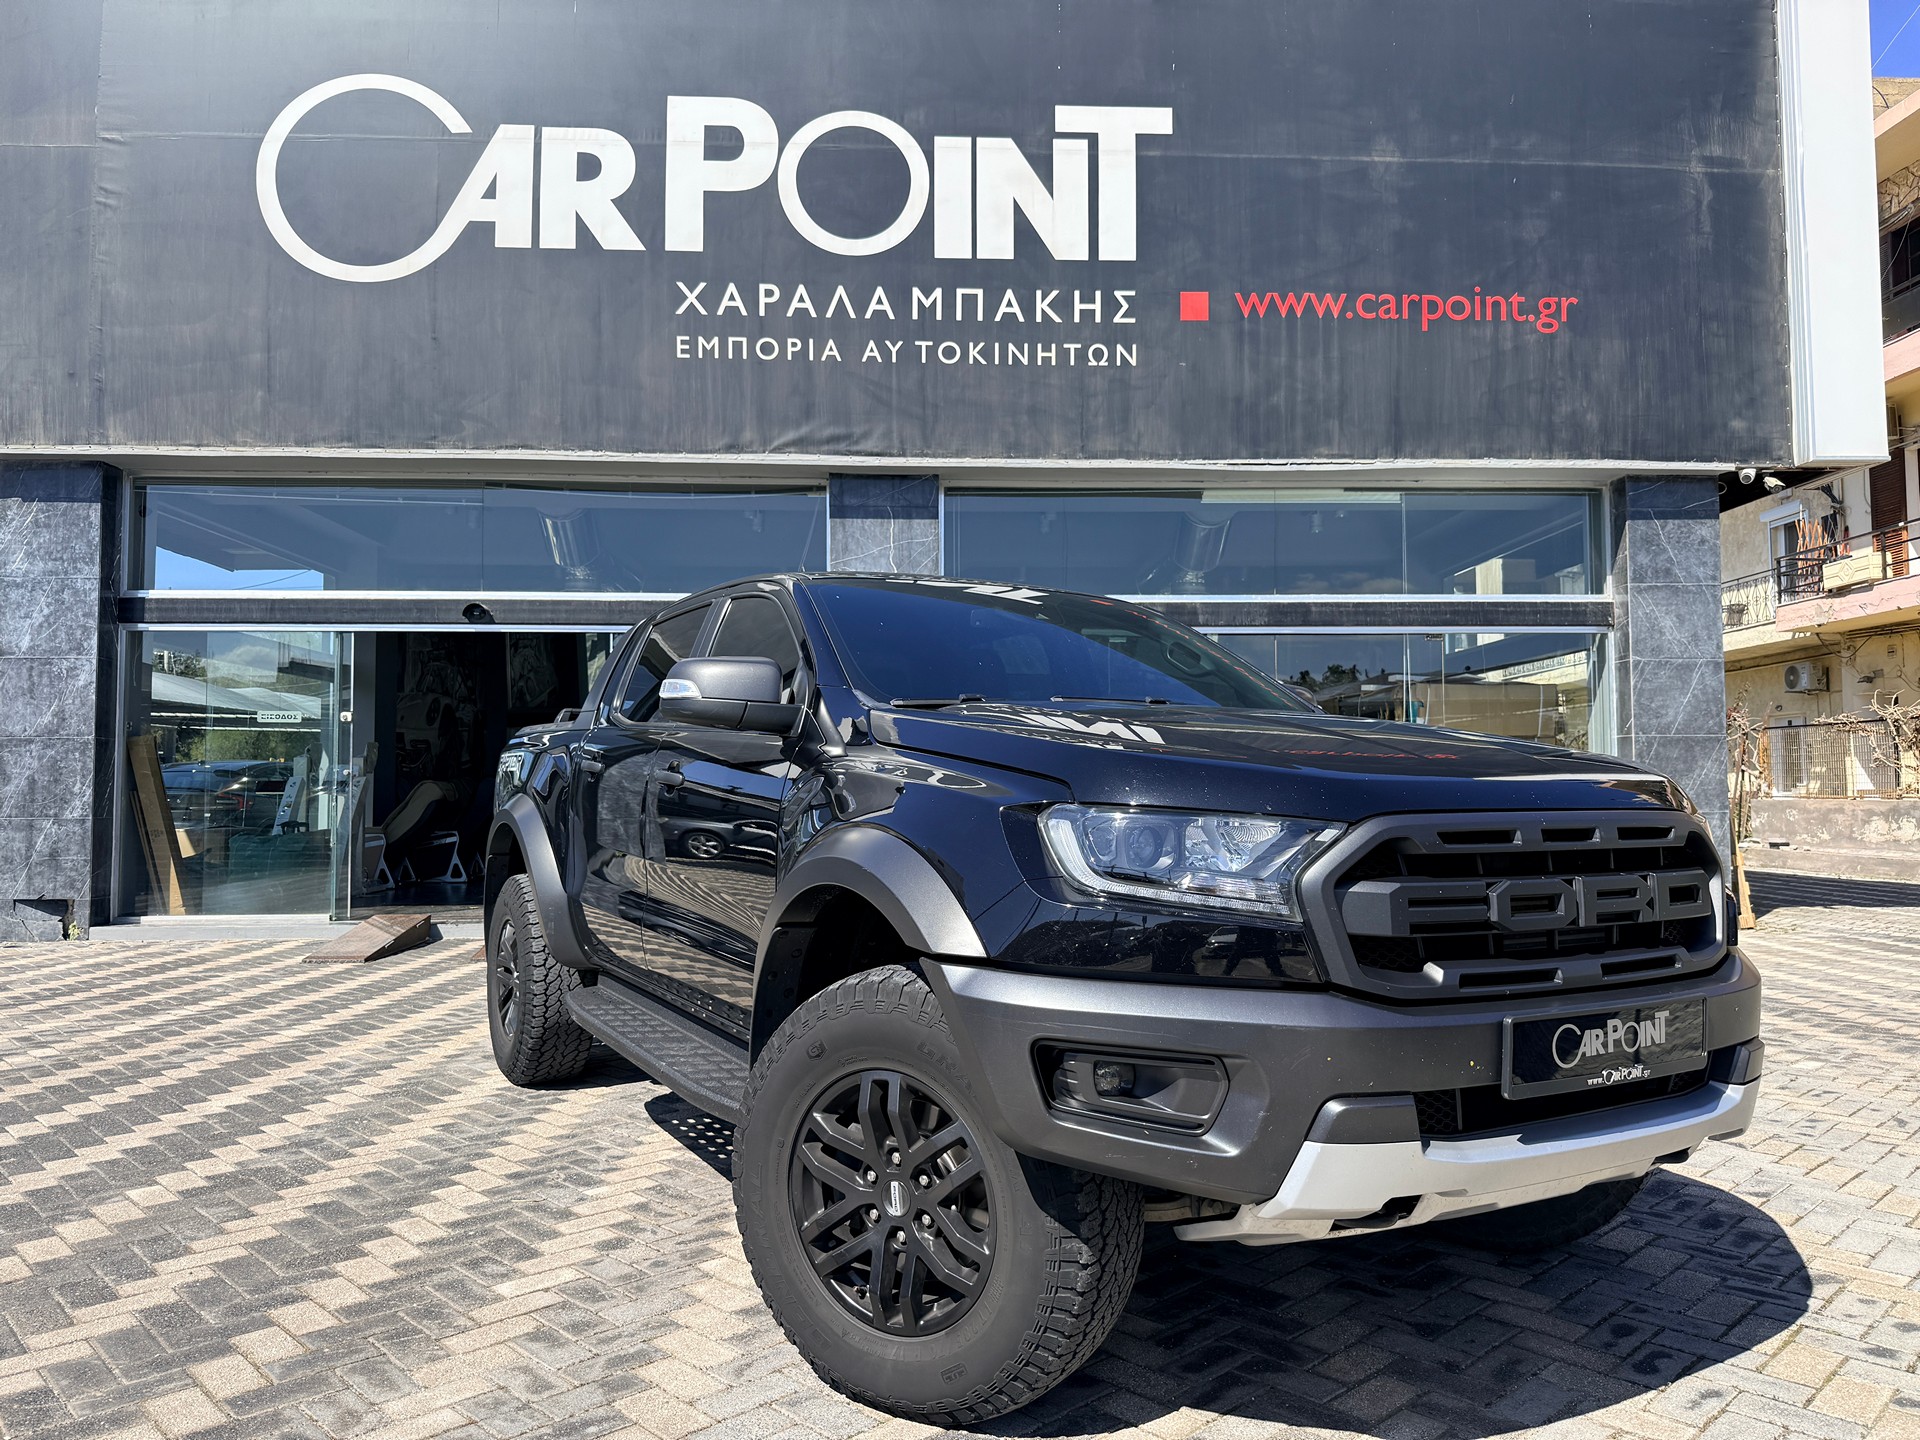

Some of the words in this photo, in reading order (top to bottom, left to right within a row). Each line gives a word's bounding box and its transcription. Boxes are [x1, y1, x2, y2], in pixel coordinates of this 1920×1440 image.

[675, 281, 1137, 324] ΧΑΡΑΛΑΜΠΑΚΗΣ
[1234, 286, 1579, 334] www.carpoint.gr
[676, 335, 842, 362] ΕΜΠΟΡΙΑ
[1397, 869, 1712, 936] FORD
